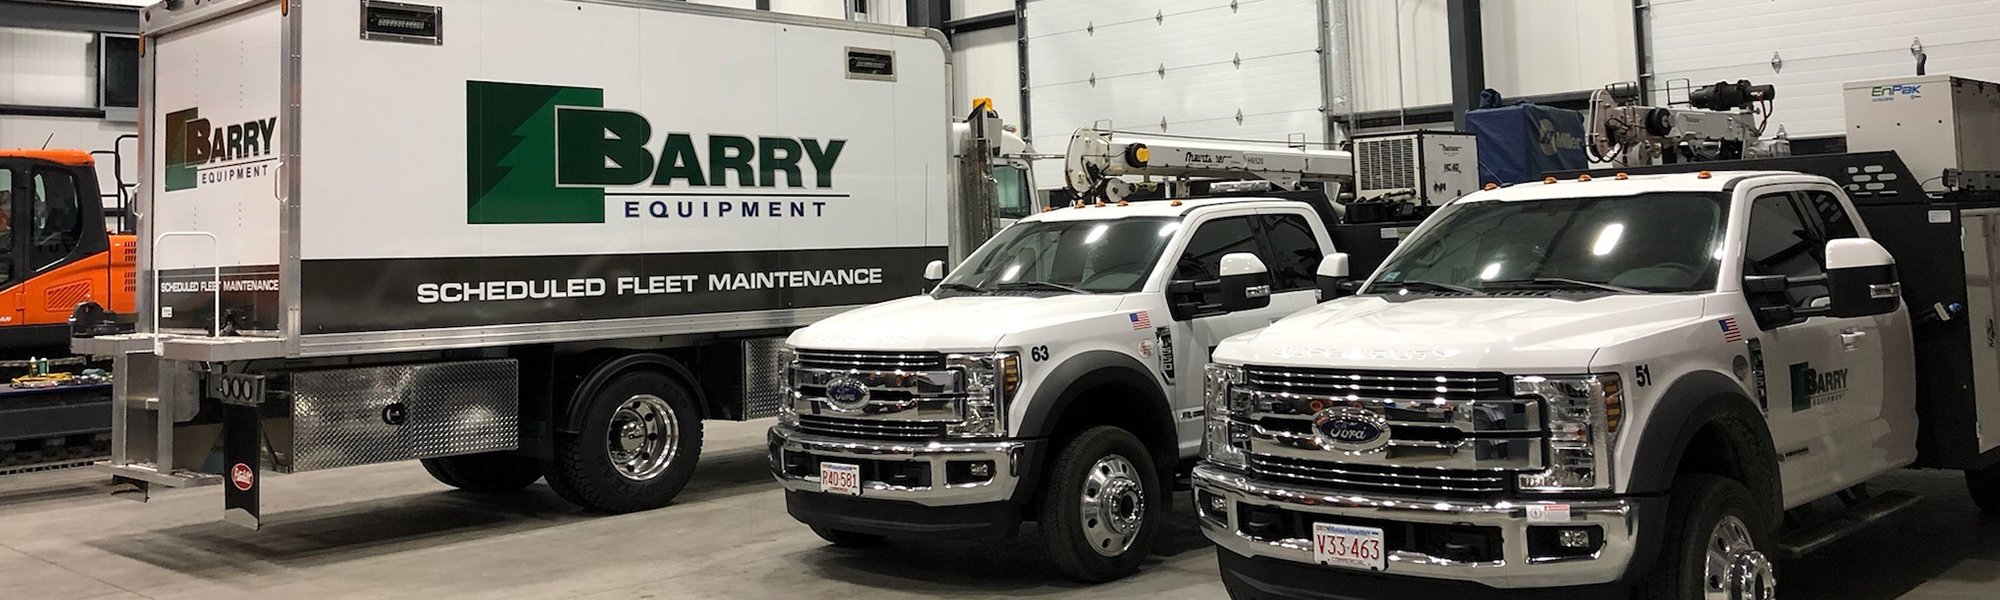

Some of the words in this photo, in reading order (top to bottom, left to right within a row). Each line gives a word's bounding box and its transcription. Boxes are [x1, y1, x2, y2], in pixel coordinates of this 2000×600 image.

[1871, 85, 1921, 96] EnPak
[185, 116, 278, 168] BARRY
[555, 105, 848, 189] BARRY
[202, 165, 268, 184] EQUIPMENT
[624, 201, 826, 218] EQUIPMENT
[161, 281, 199, 292] SCHEDULED
[223, 280, 279, 291] MAINTENANCE
[417, 277, 606, 303] SCHEDULED
[617, 275, 698, 295] FLEET
[708, 268, 883, 291] MAINTENANCE
[1031, 345, 1049, 362] 63
[1635, 364, 1651, 387] 51
[1803, 368, 1848, 396] BARRY
[1330, 420, 1367, 440] Ford
